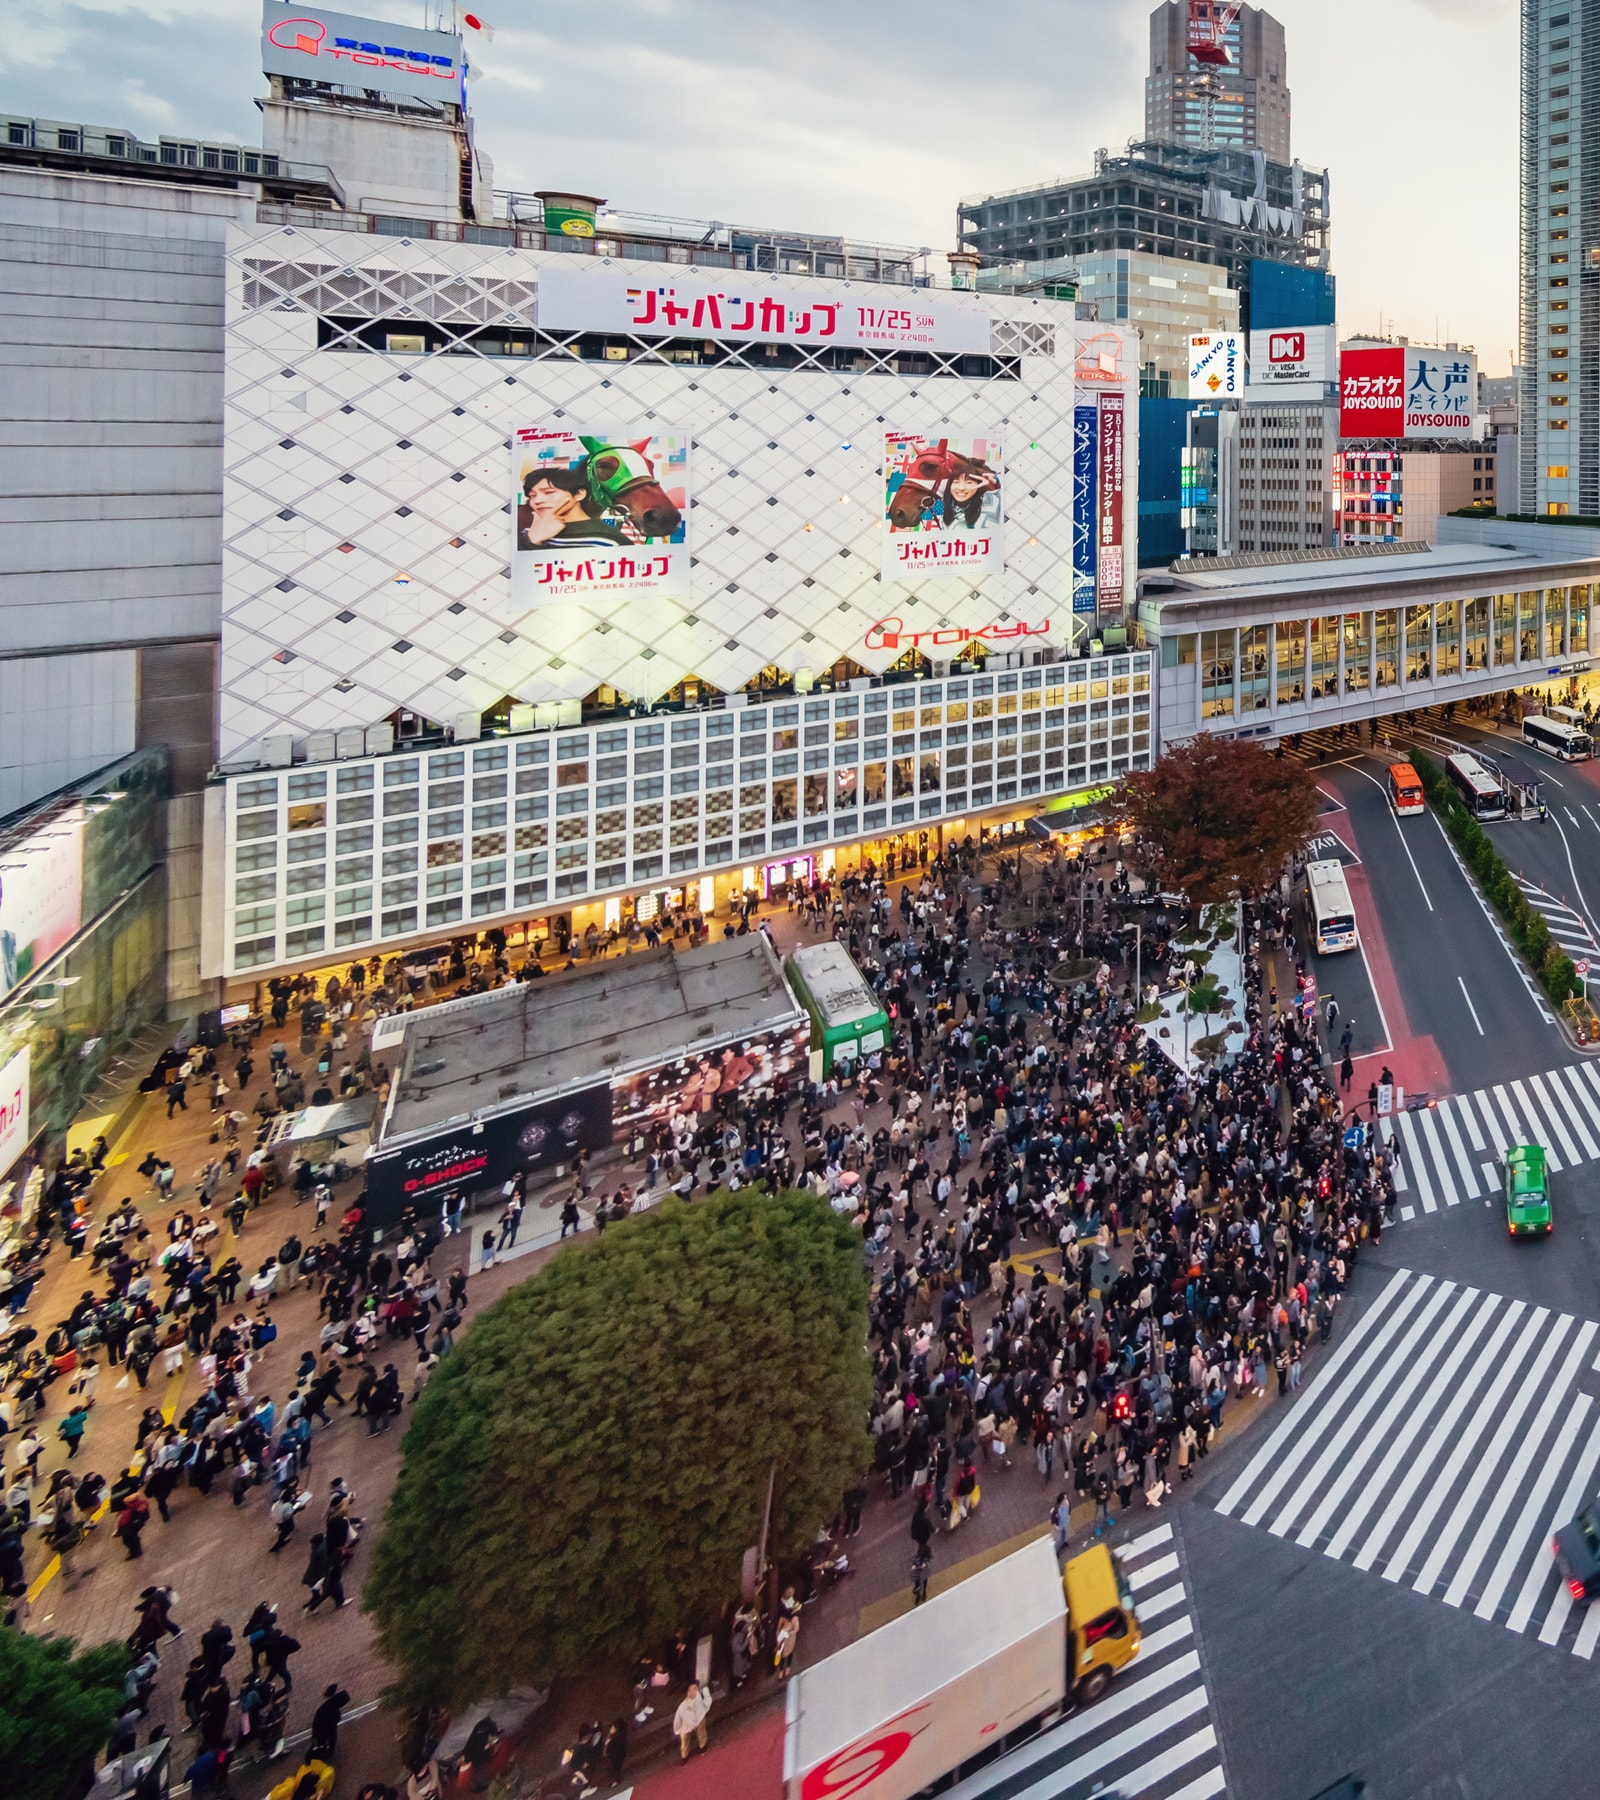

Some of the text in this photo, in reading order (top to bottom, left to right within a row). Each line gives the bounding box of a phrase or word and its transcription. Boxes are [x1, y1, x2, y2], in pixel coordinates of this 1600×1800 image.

[324, 48, 455, 79] TOKYU
[626, 287, 935, 337] ジャパンカップ 11/25 SUN
[1191, 341, 1224, 379] SANKYO
[1227, 338, 1238, 392] SANKYO
[1280, 363, 1295, 371] VISA
[1274, 371, 1310, 379] MasterCard
[1344, 376, 1401, 395] カラオケ
[1408, 360, 1470, 393] 大声
[1343, 396, 1403, 410] JOYSOUND
[1407, 393, 1469, 412] だそうぜ
[1406, 413, 1470, 427] JOYSOUND
[897, 537, 992, 561] ジャパンカップ
[534, 554, 674, 584] ジャパンカップ
[907, 562, 926, 570] 11/25
[549, 585, 576, 595] 11/25
[898, 618, 1051, 648] TOKYU
[404, 1155, 488, 1192] G-SHOCK
